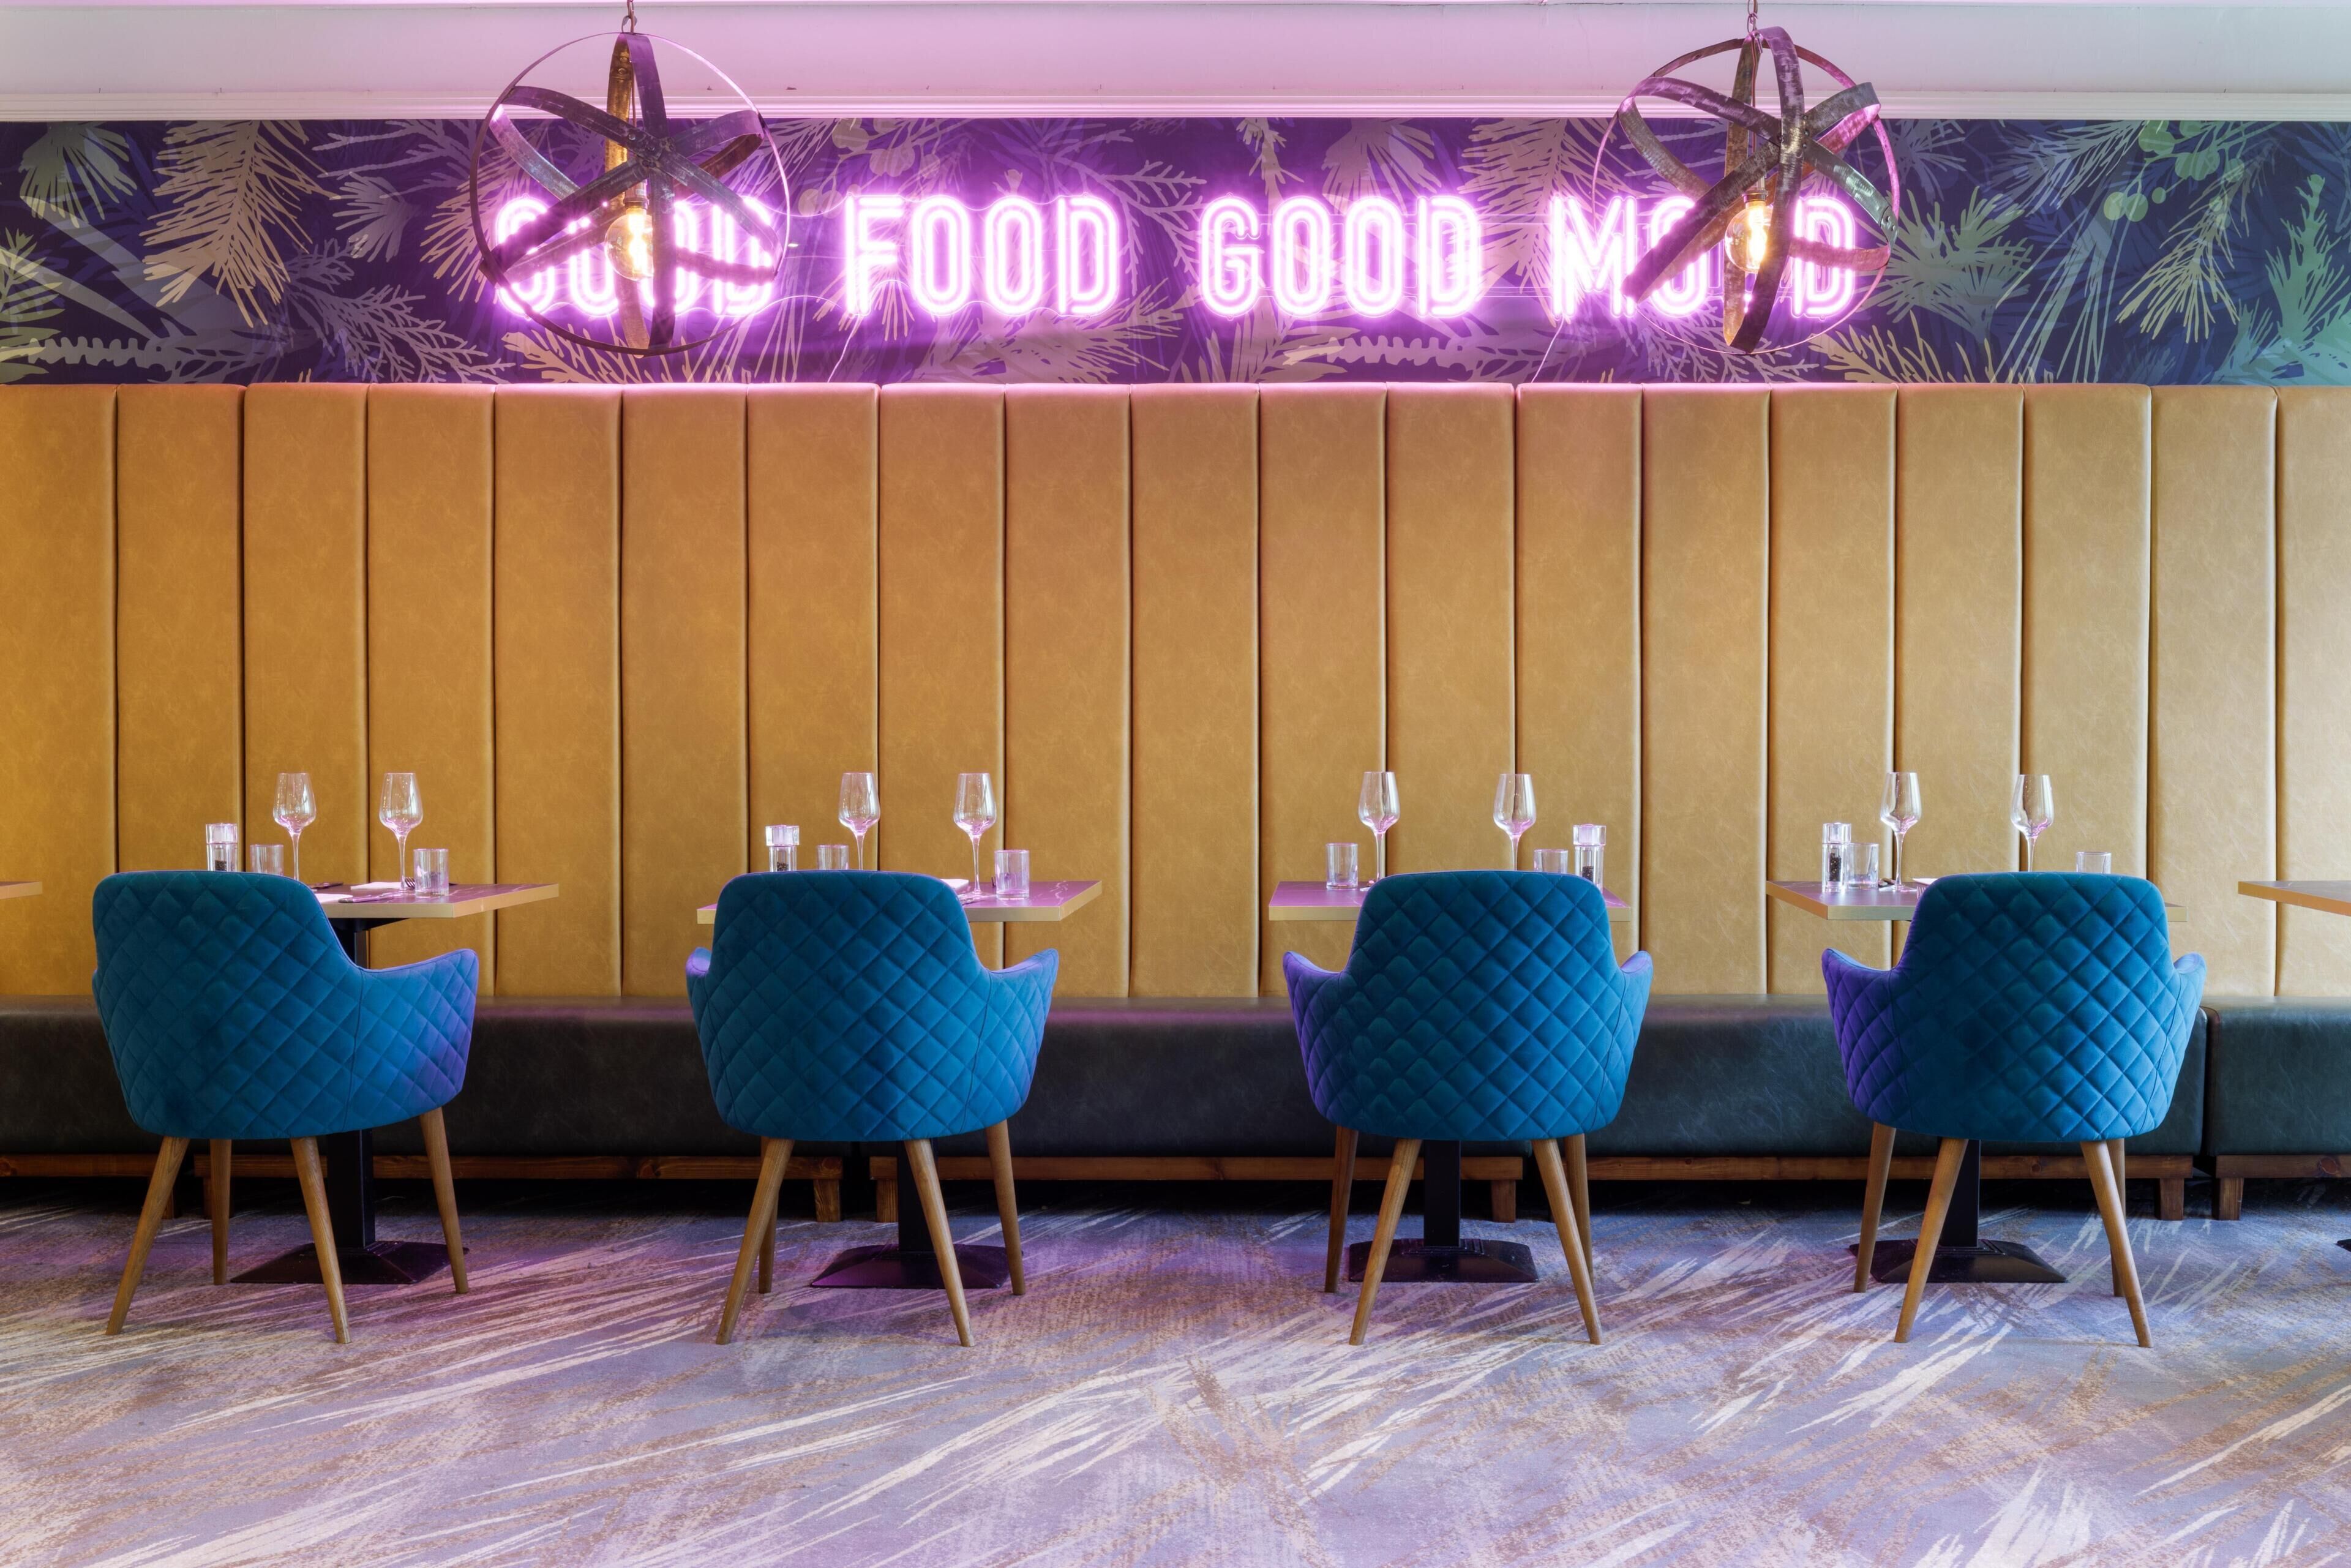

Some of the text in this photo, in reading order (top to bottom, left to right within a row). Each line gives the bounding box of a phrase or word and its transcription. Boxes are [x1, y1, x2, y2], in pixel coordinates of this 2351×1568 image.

[845, 195, 1120, 316] FOOD
[1199, 195, 1482, 316] GOOD
[1550, 195, 1856, 318] MOD
